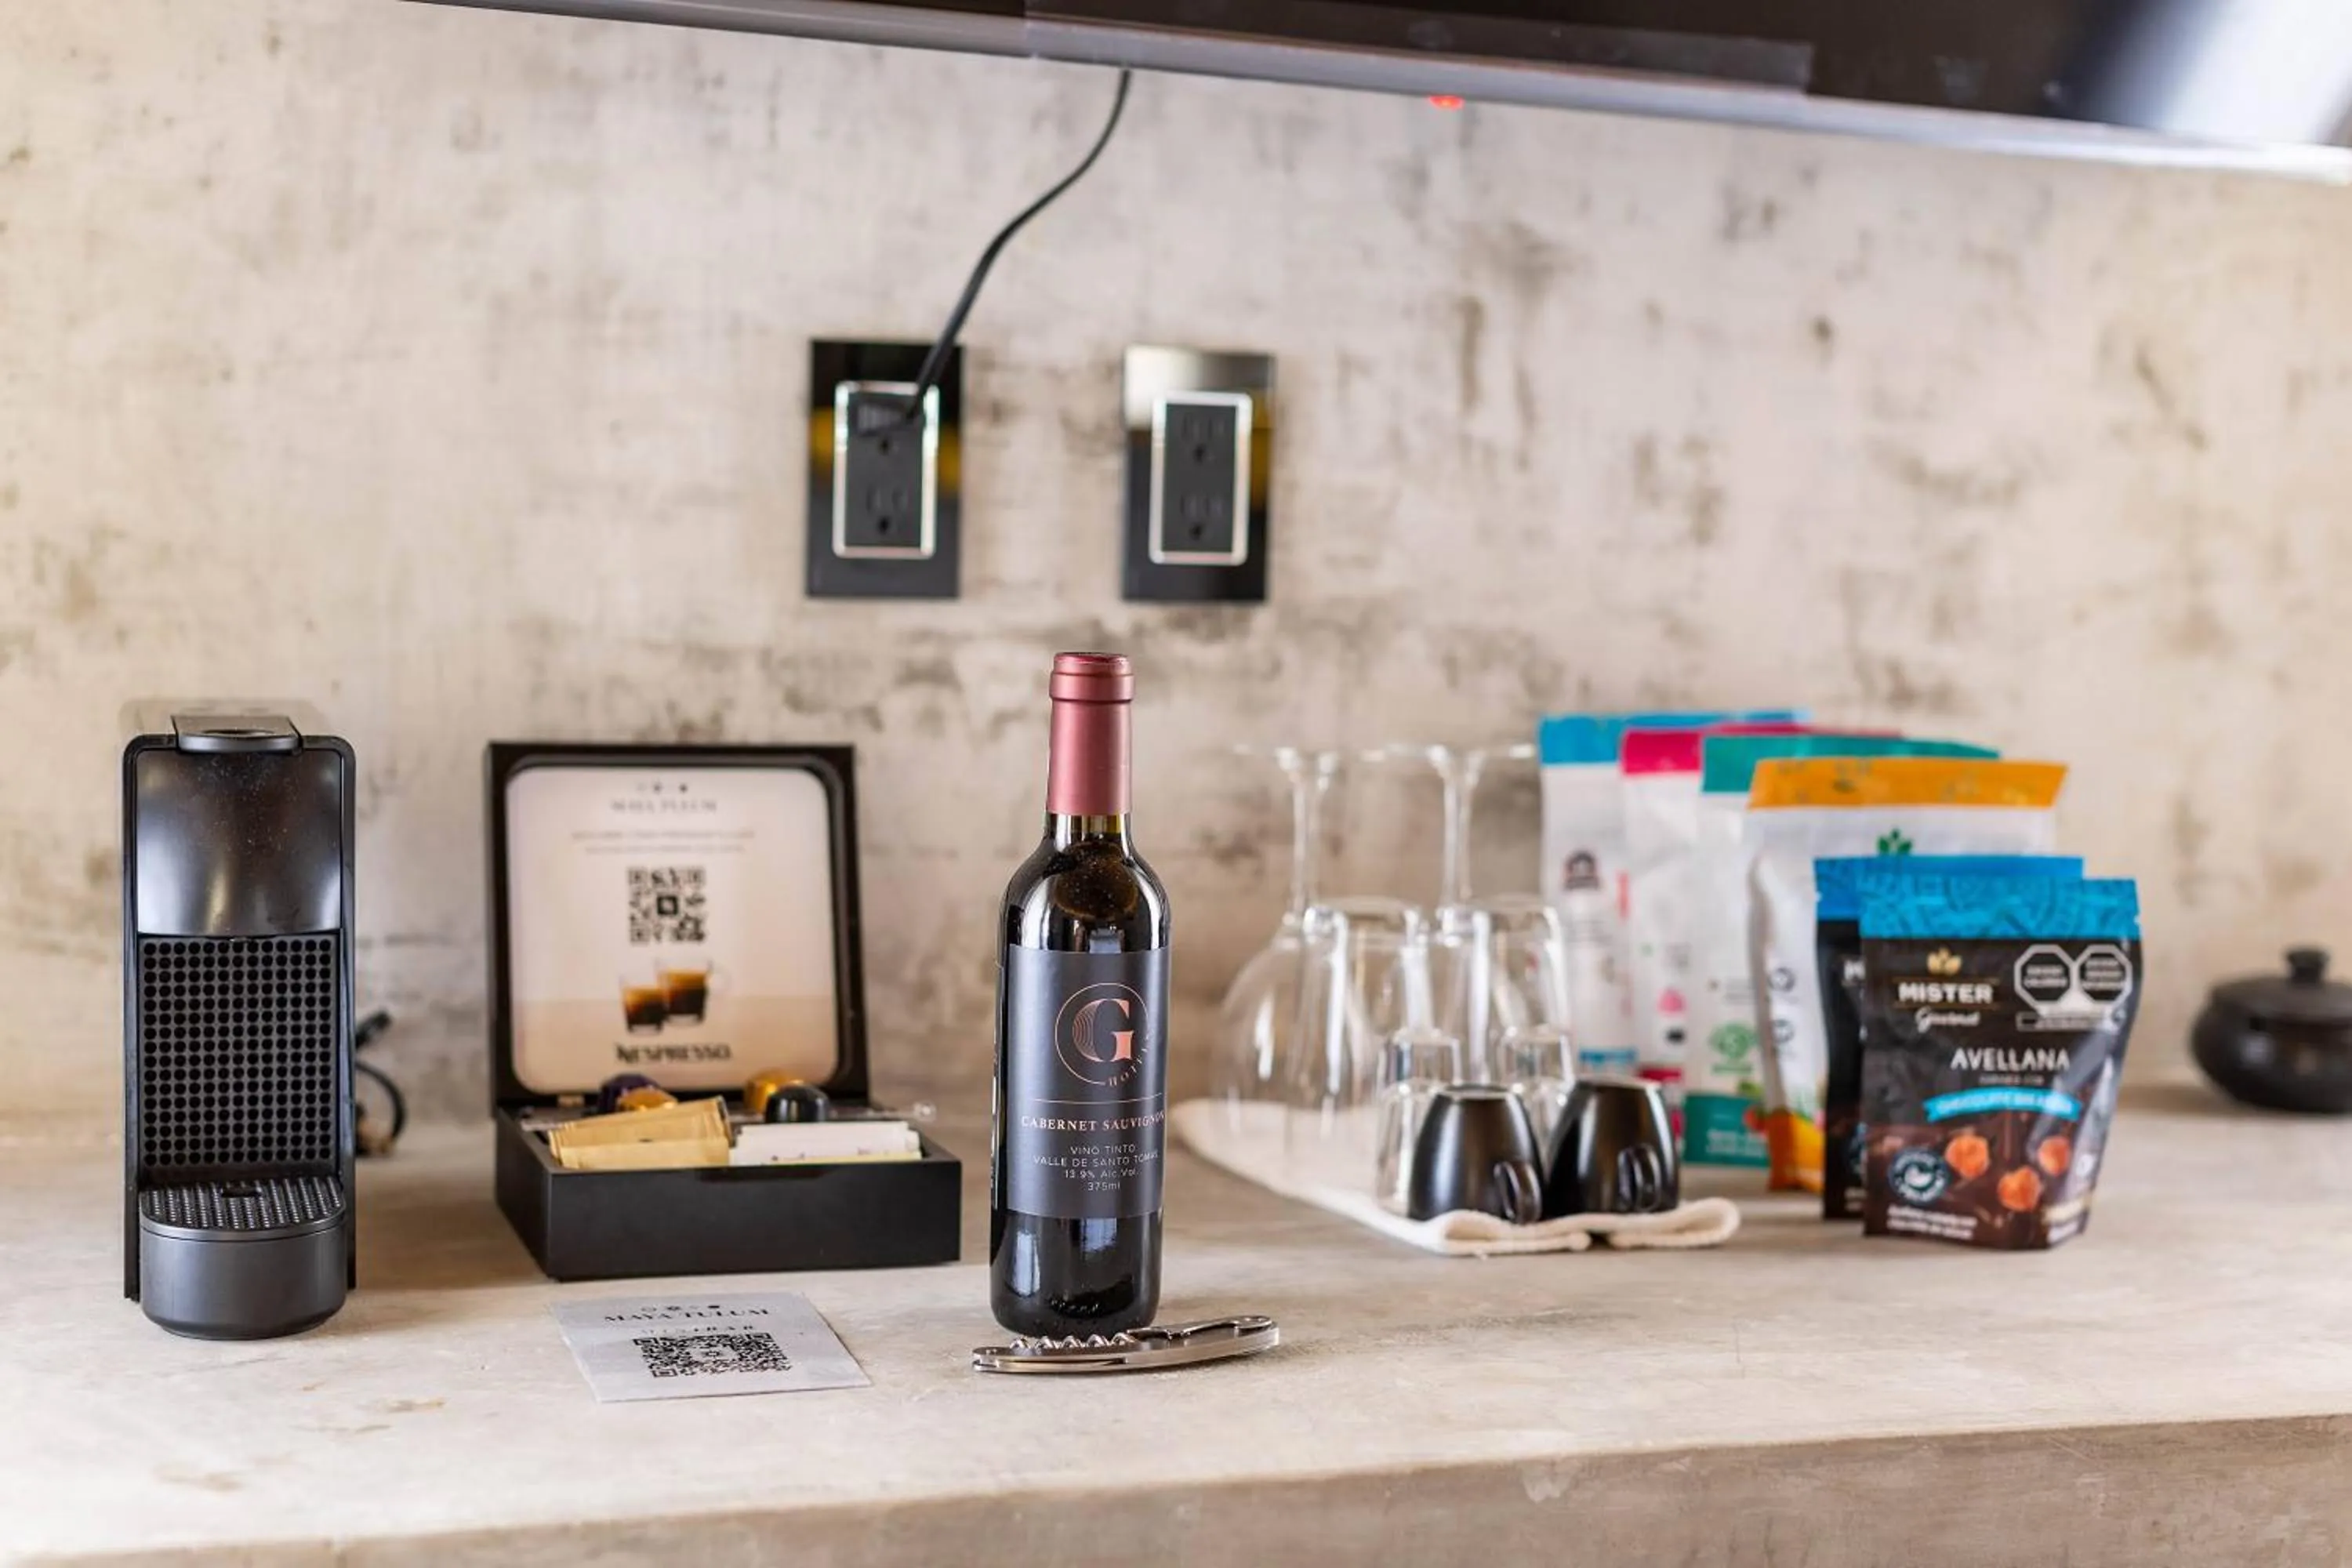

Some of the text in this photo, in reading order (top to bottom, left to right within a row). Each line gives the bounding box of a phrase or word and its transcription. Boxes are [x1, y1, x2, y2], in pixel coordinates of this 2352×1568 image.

[1898, 982, 1993, 1003] MISTER
[1073, 998, 1134, 1062] G
[1950, 1047, 2071, 1071] AVELLANA
[1021, 1116, 1097, 1131] CABERNET
[1070, 1144, 1136, 1155] VINO TINTO
[1033, 1156, 1067, 1167] VALLE
[1072, 1158, 1087, 1167] DE
[1093, 1156, 1130, 1167] SANTO
